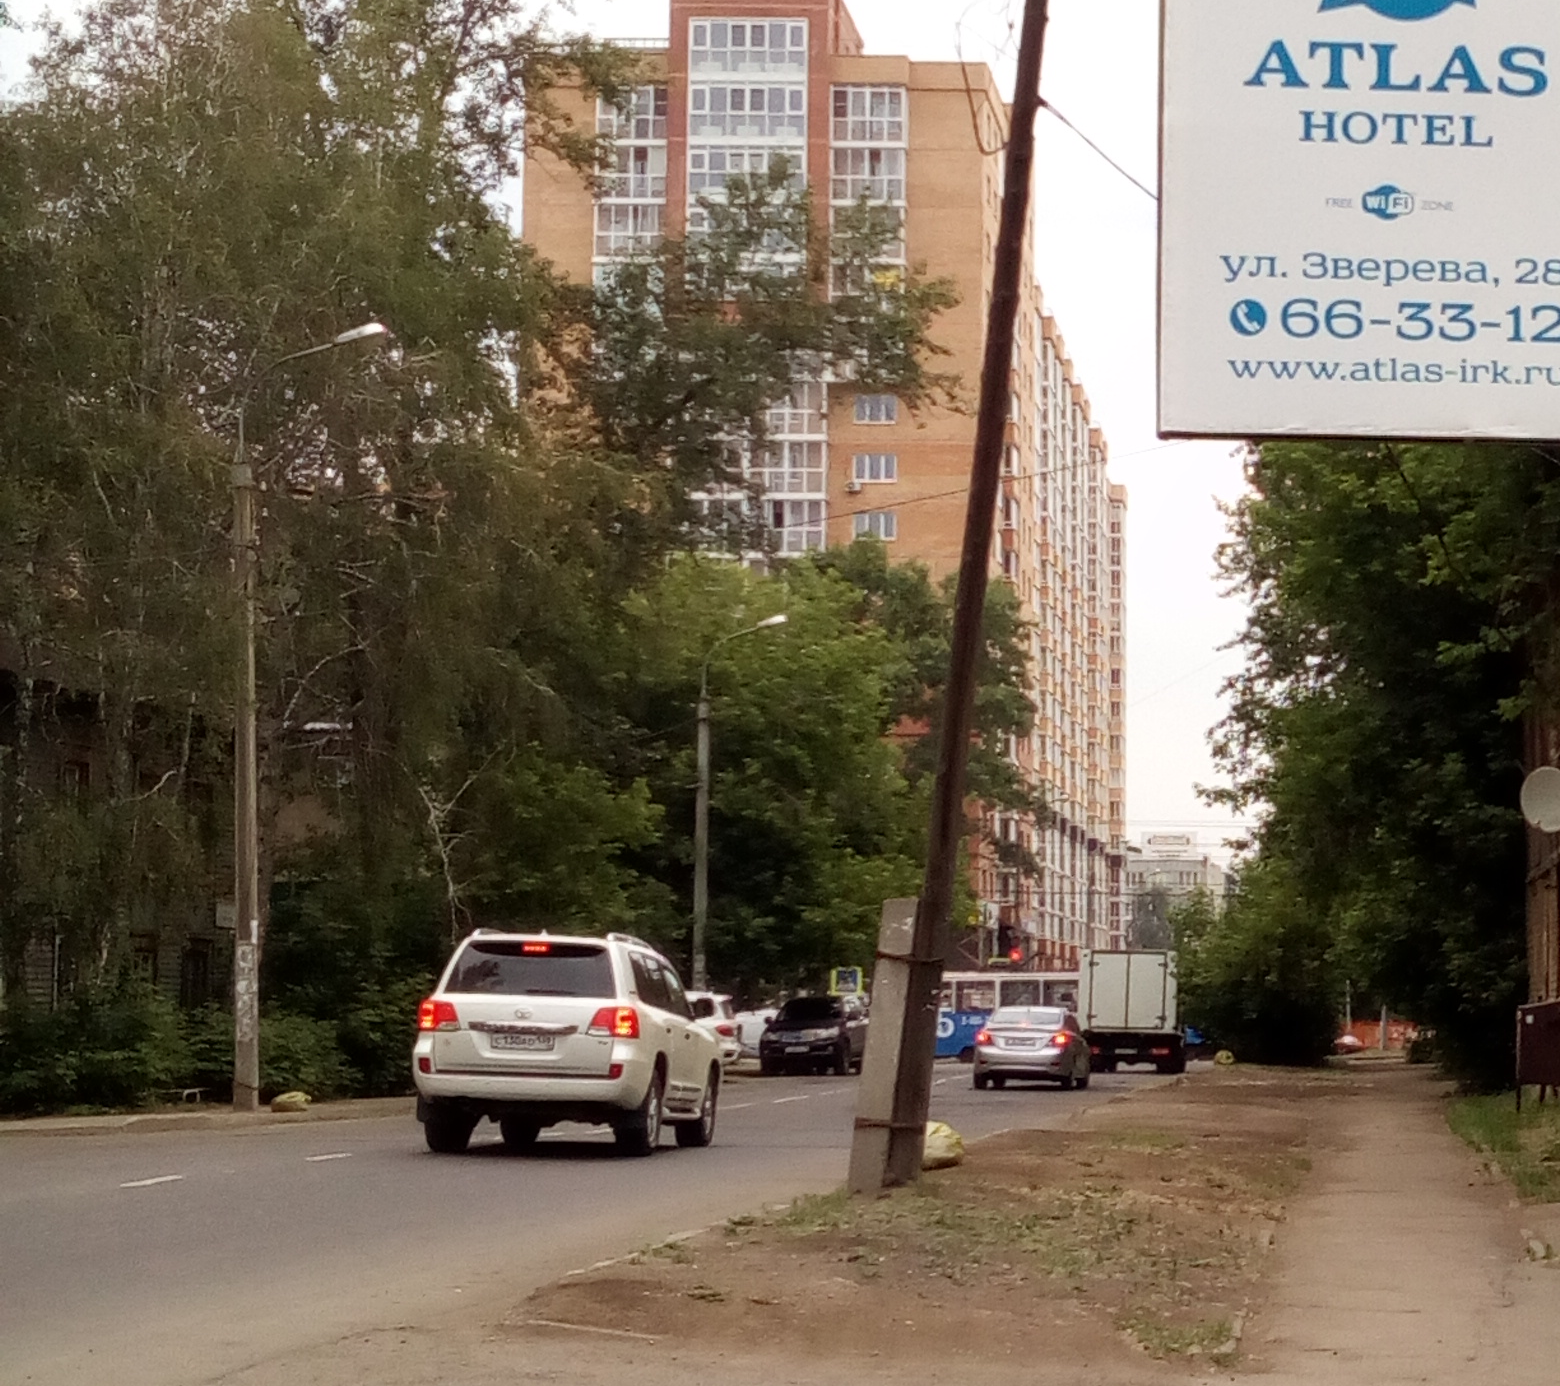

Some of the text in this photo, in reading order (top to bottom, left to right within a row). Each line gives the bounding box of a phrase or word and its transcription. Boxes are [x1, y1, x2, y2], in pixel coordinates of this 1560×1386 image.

[1244, 37, 1549, 98] ATLAS
[1299, 109, 1494, 148] HOTEL
[1220, 254, 1288, 283] ул.
[1302, 252, 1500, 288] Зверева,
